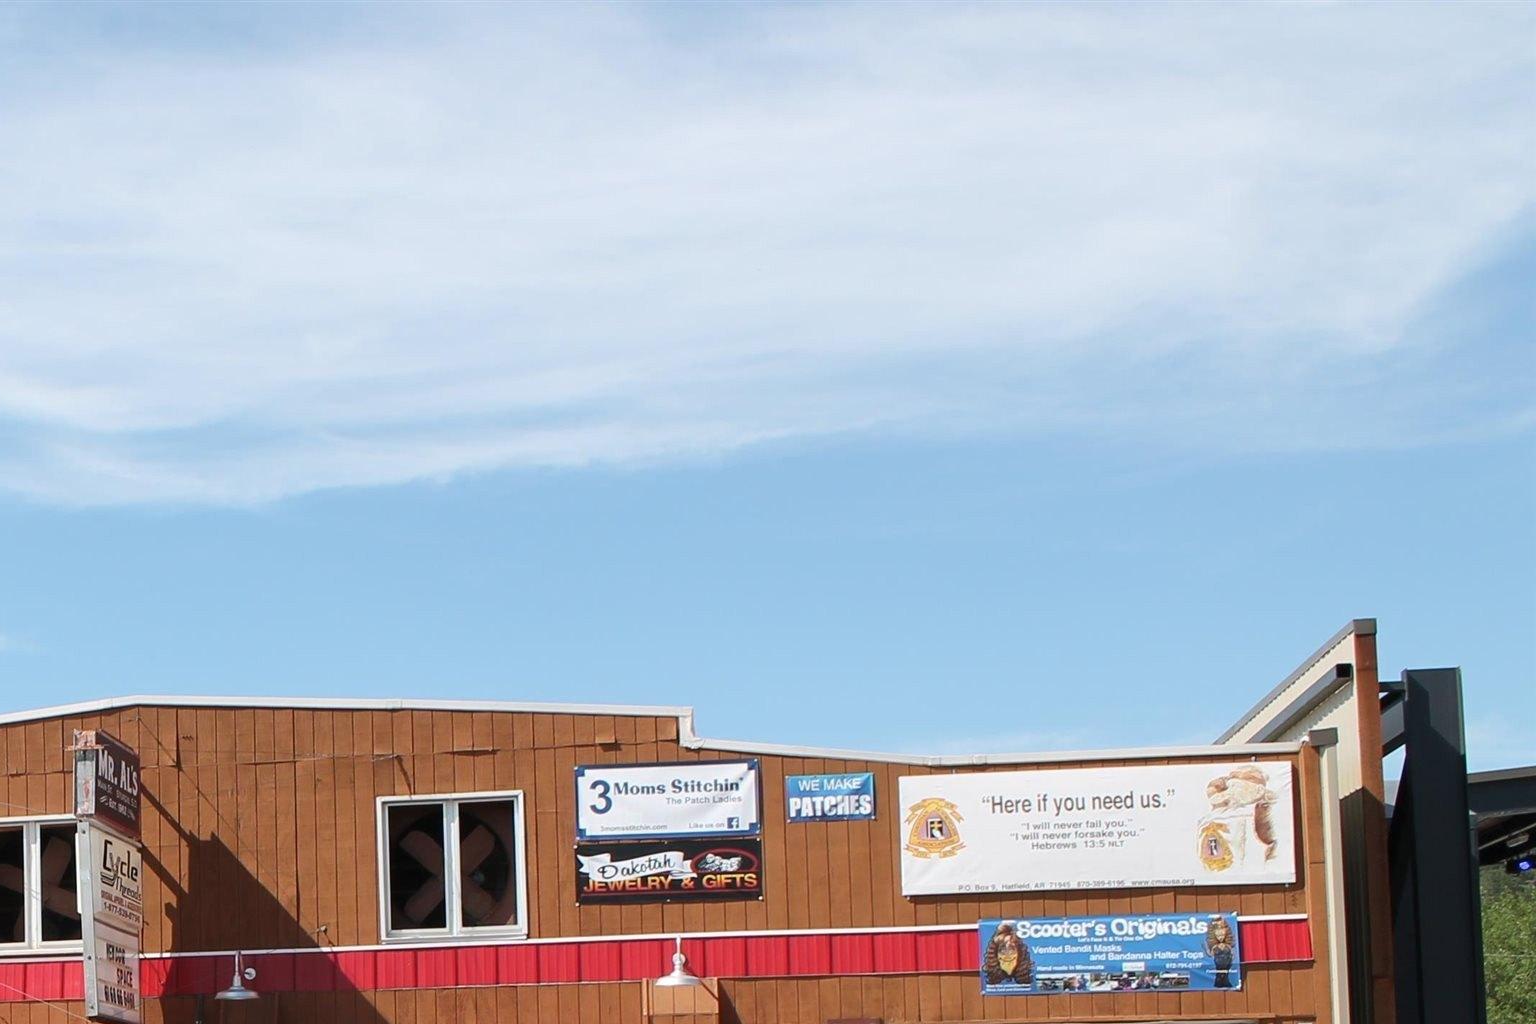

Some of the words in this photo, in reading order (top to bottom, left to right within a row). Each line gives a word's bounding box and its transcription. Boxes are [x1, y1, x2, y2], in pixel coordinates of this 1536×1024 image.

[98, 748, 117, 785] MR.
[120, 760, 138, 796] AL'S
[614, 782, 666, 795] Moms
[798, 779, 819, 791] WE
[824, 778, 861, 790] MAKE
[590, 779, 612, 814] 3
[665, 797, 682, 805] The
[684, 796, 710, 804] Patch
[712, 795, 742, 803] Ladies
[1037, 794, 1047, 812] if
[1053, 796, 1085, 816] you
[1092, 791, 1134, 810] need
[789, 794, 872, 817] PATCHES
[1033, 821, 1051, 830] will
[1053, 822, 1082, 830] never
[1021, 832, 1039, 841] will
[1042, 832, 1071, 840] never
[1074, 830, 1114, 839] forsake
[1031, 841, 1077, 850] Hebrews
[1084, 840, 1105, 848] 13:5
[1108, 840, 1124, 848] NLT
[100, 839, 139, 884] Cycle
[597, 854, 675, 879] Dakotah
[584, 875, 672, 892] JEWELRY
[681, 876, 695, 888] &
[702, 873, 757, 889] GIFTS
[1016, 919, 1107, 939] Scooter's
[1111, 917, 1208, 939] Originals
[1032, 945, 1063, 954] Vented
[1065, 944, 1092, 953] Bandit
[1094, 944, 1122, 953] Masks
[1108, 952, 1152, 960] Bandanna
[1154, 950, 1181, 959] Halter
[1182, 951, 1203, 961] Tops
